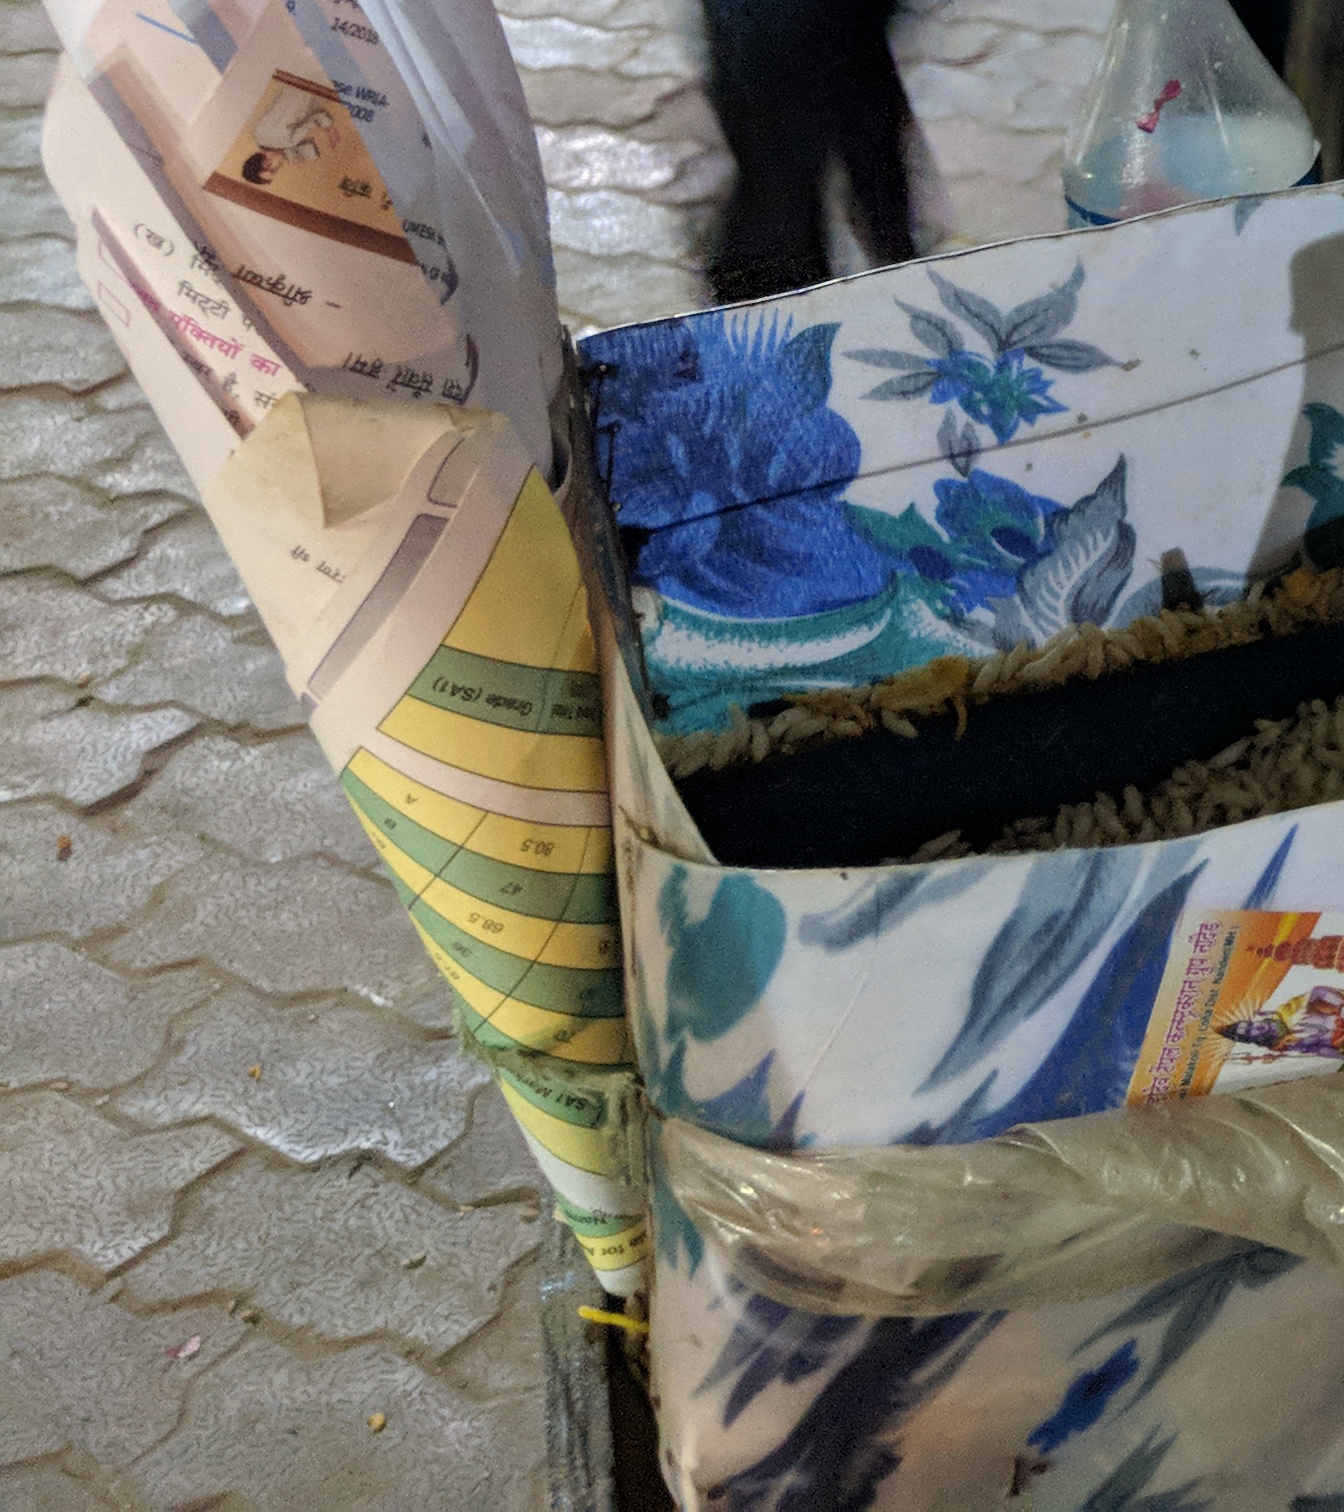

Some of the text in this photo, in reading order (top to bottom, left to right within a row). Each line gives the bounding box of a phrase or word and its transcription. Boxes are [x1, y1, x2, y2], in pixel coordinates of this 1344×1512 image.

[231, 264, 313, 307] श्रीकृष्ण
[249, 353, 282, 377] का
[486, 694, 533, 717] Grade
[405, 793, 418, 804] A
